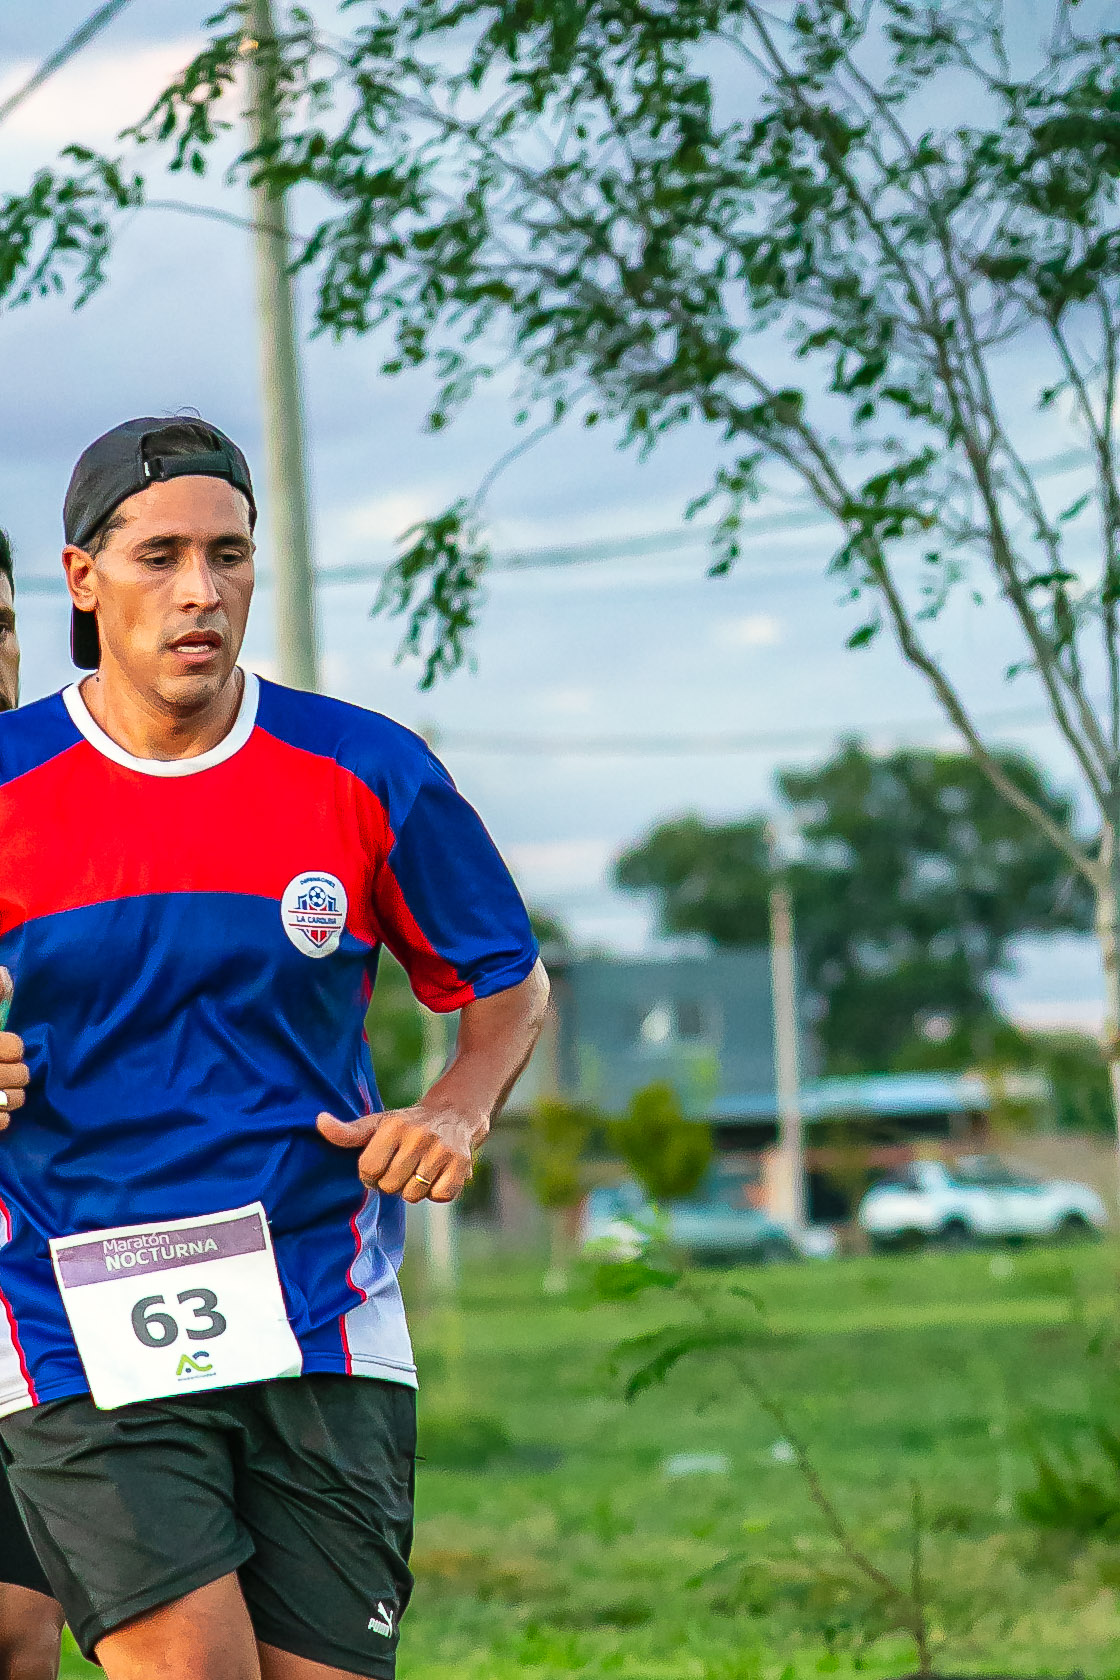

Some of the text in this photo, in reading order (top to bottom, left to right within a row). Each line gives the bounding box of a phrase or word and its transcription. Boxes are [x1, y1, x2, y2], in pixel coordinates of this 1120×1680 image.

[103, 1232, 170, 1254] Maratón
[105, 1237, 219, 1272] NOCTURNA
[131, 1288, 227, 1348] 63
